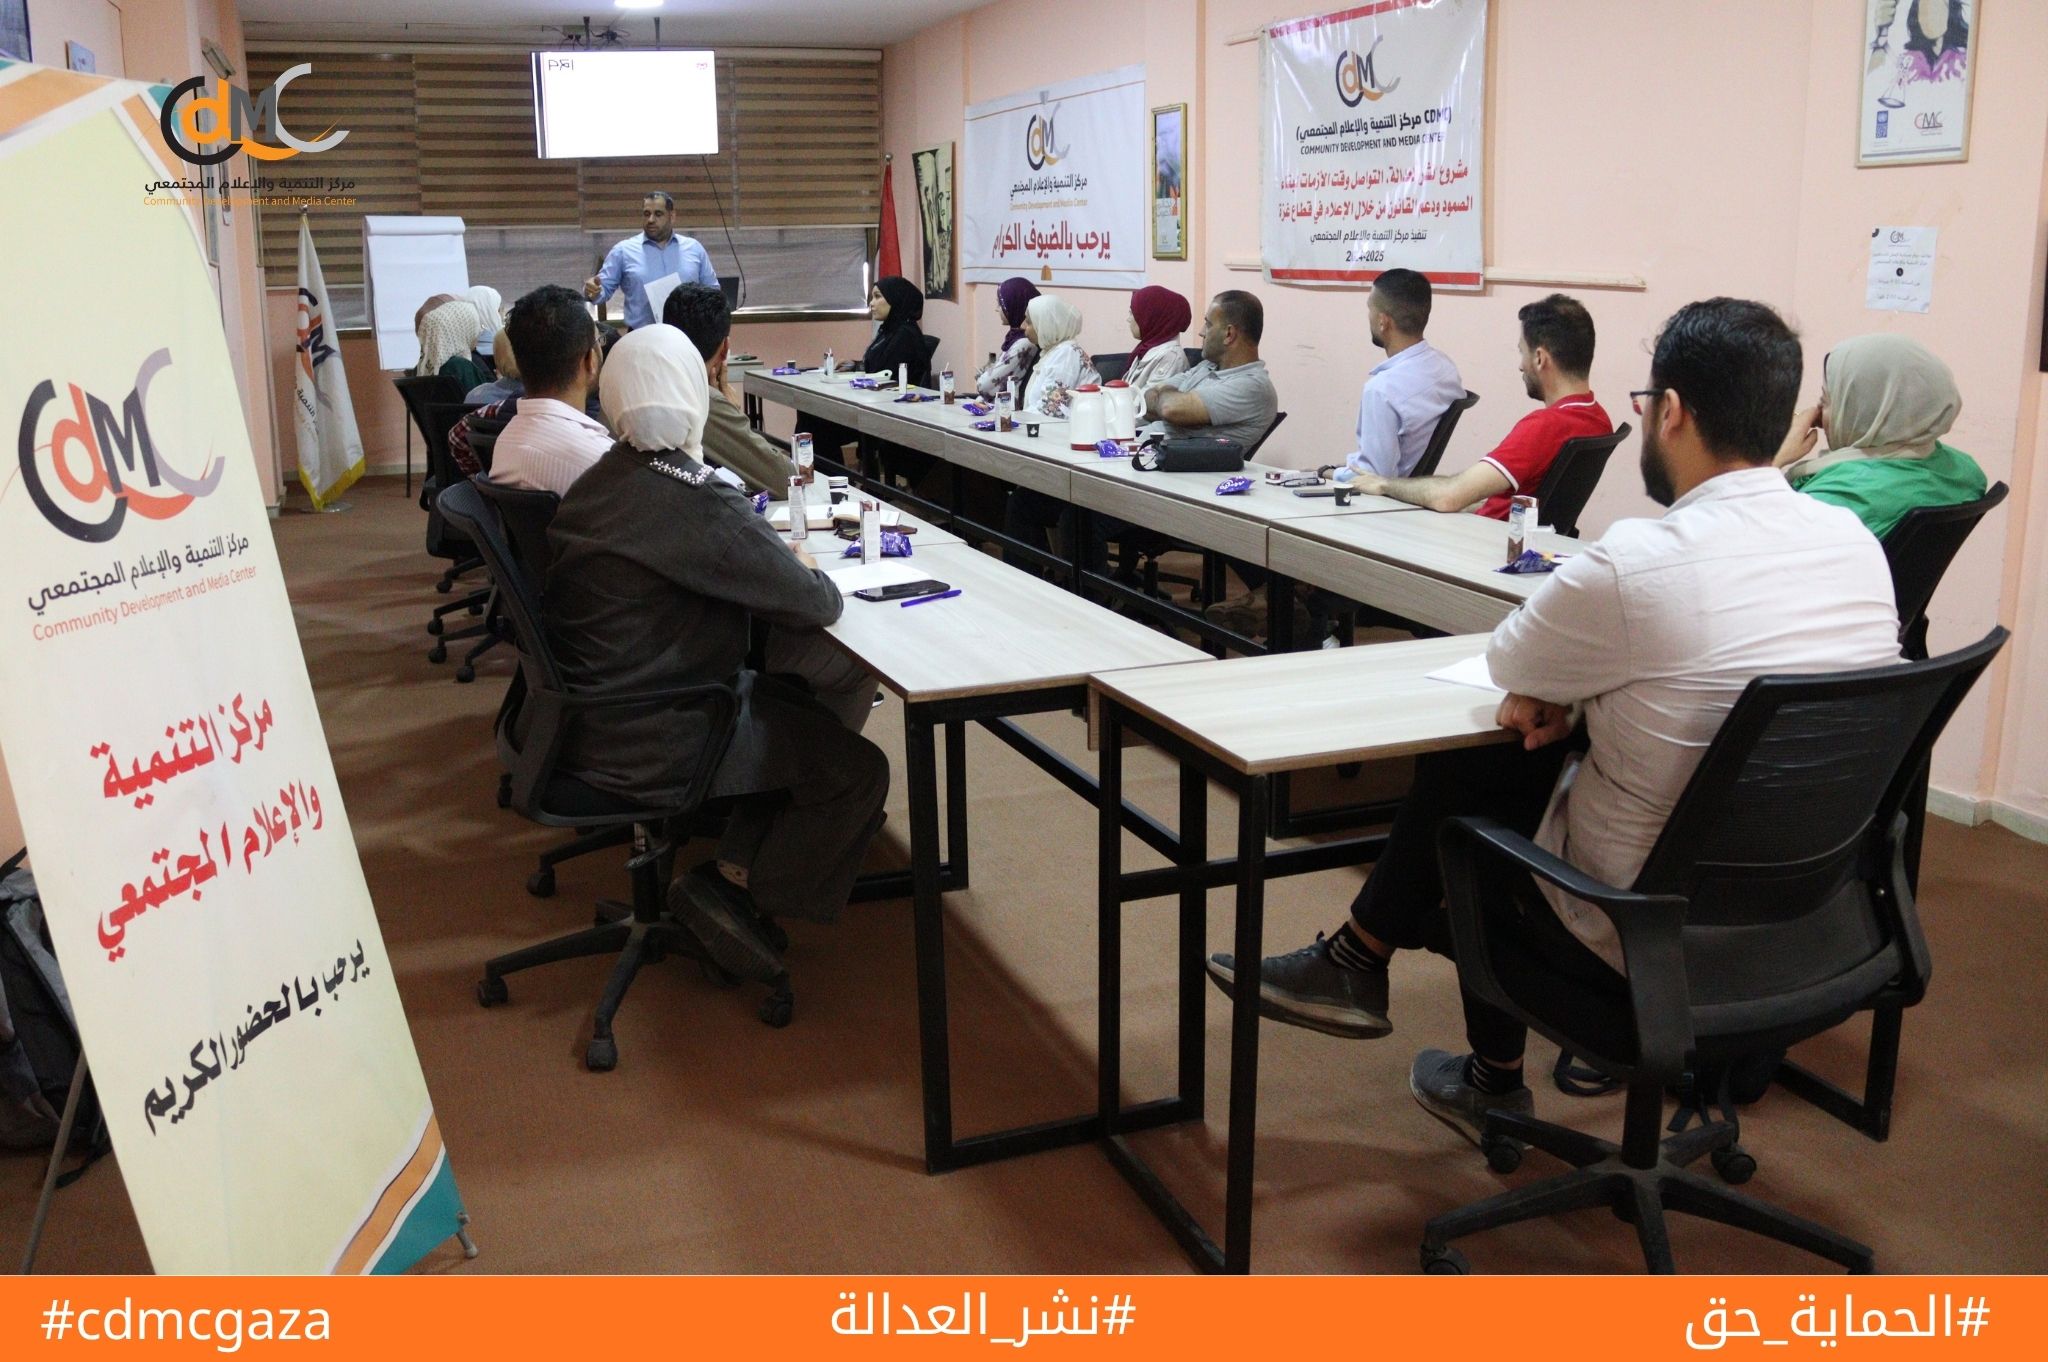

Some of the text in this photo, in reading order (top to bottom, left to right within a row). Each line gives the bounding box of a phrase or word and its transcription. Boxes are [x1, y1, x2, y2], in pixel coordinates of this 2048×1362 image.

[1339, 118, 1369, 138] والإعلام
[1370, 114, 1397, 133] التنمية
[1400, 113, 1422, 131] مركز
[1300, 143, 1339, 155] COMMUNITY
[1340, 139, 1382, 152] DEVELOPMENT
[1383, 137, 1397, 148] AND
[1398, 134, 1421, 147] MEDIA
[1053, 173, 1074, 193] التنمية
[1074, 173, 1088, 191] مركز
[1331, 170, 1350, 191] وقت
[1350, 169, 1384, 190] التواصل
[1438, 159, 1468, 186] مشروع
[1010, 177, 1033, 201] المجتمعي
[1278, 202, 1292, 222] غزة
[1291, 201, 1313, 222] قطاع
[1313, 199, 1325, 224] في
[1354, 199, 1374, 221] خلال
[1442, 194, 1473, 217] الصمود
[991, 219, 1111, 260] يرحب بالضيوف الكرام
[1371, 229, 1393, 244] التنمية
[1393, 229, 1409, 244] مركز
[1410, 229, 1428, 243] تنفيذ
[28, 532, 249, 616] مركز التنمية والإعلام المجتمعي
[32, 564, 257, 642] Community Development and Media Center
[89, 692, 273, 810] مركز التنمية
[97, 778, 323, 963] والإعلام المجتمعي
[143, 938, 370, 1137] يرحب بالحضور الكريم
